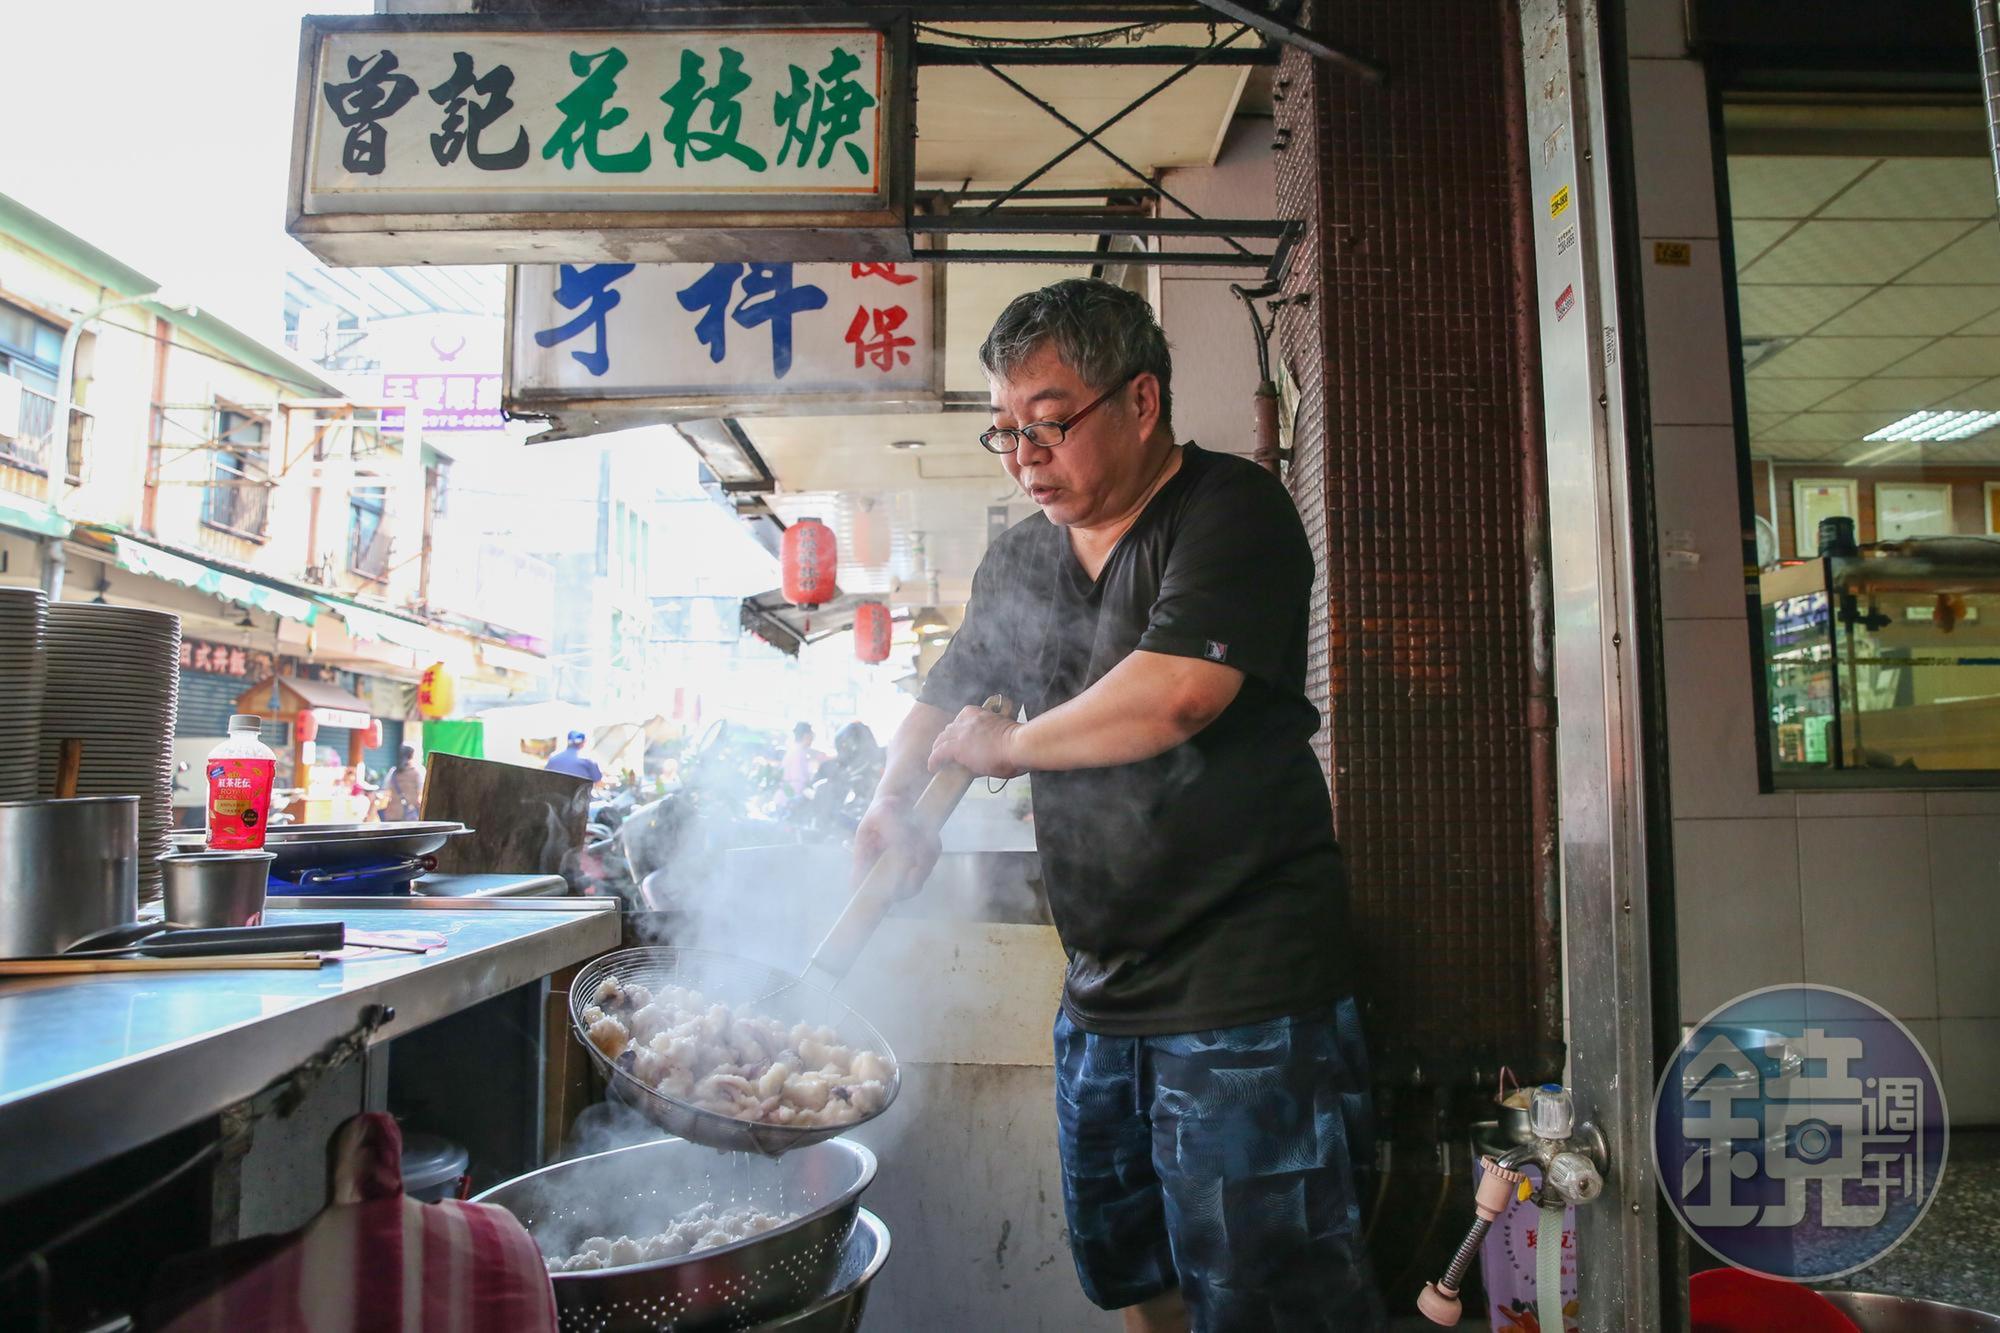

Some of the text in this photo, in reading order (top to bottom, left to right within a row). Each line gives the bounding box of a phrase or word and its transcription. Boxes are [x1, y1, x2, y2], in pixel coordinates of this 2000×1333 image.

[323, 47, 878, 175] 曾記花枝焿
